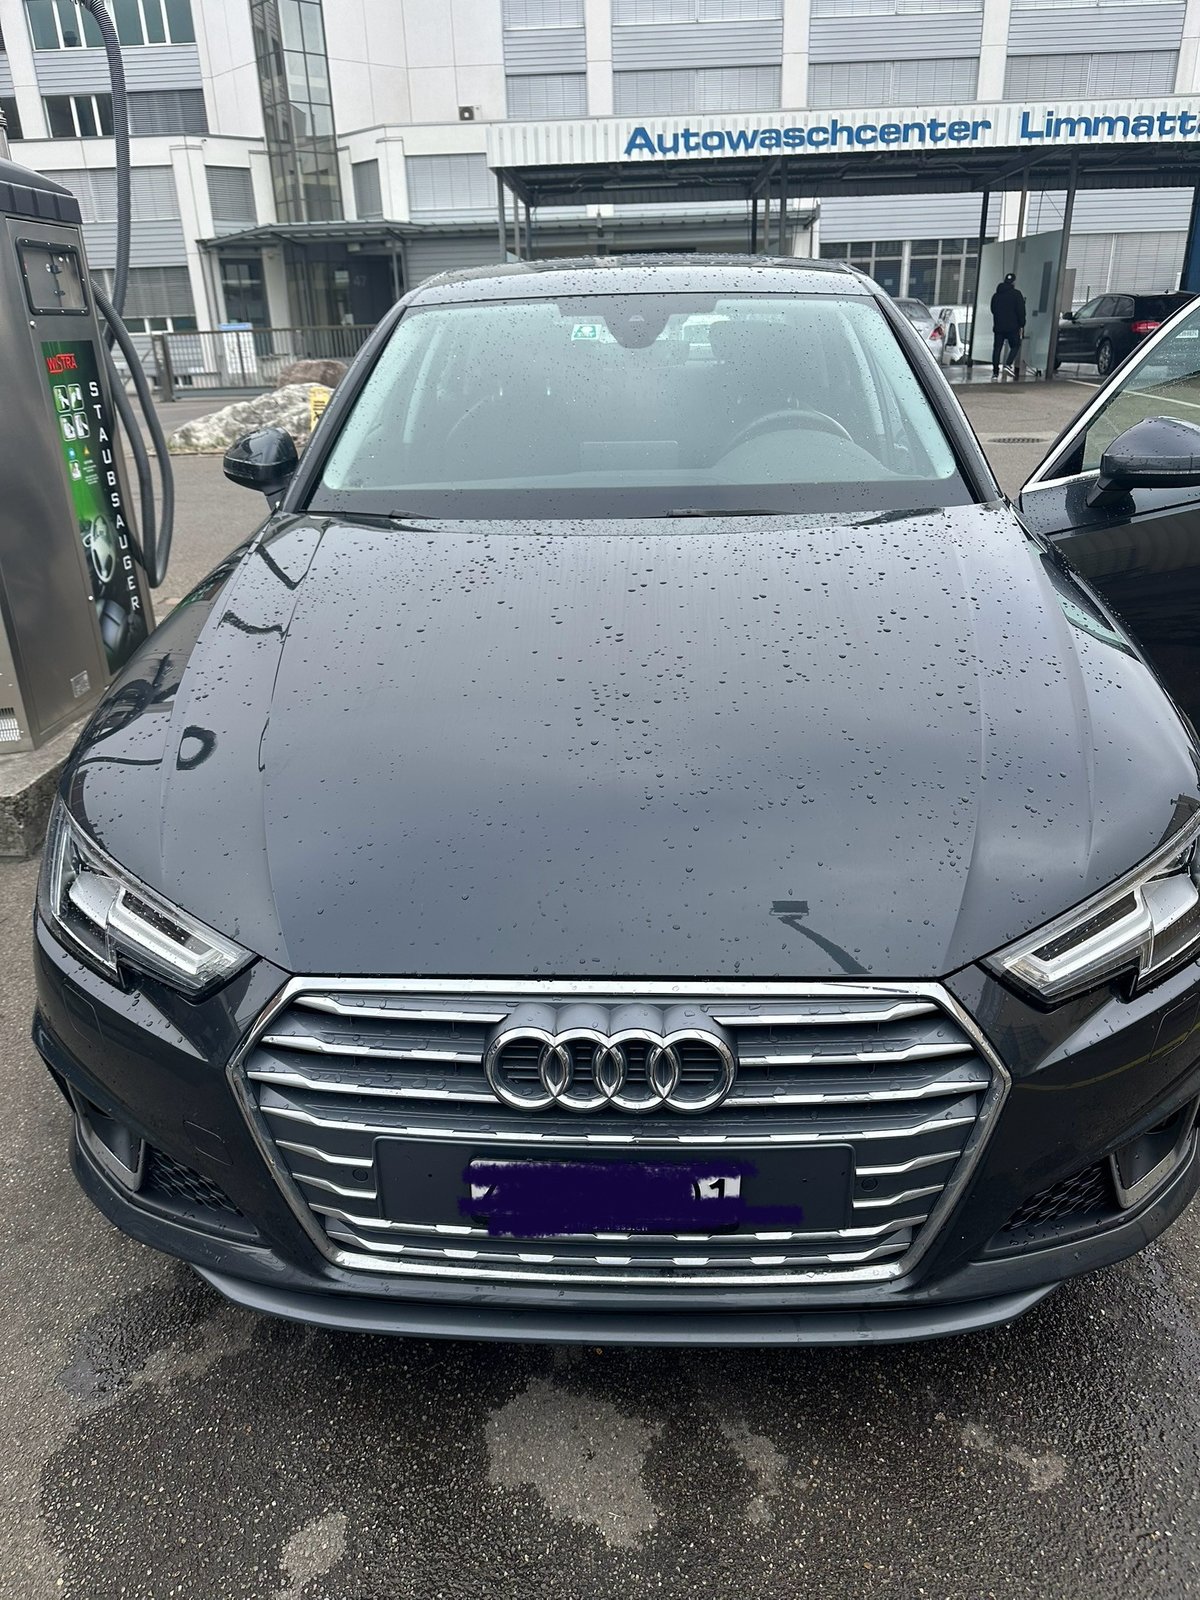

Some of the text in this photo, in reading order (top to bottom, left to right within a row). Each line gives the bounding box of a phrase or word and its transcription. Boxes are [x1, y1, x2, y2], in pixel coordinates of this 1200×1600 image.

[625, 110, 1200, 156] Autowaschcenter Limmatt
[46, 353, 78, 374] WISTRA
[88, 381, 141, 611] STAUBSAUGER
